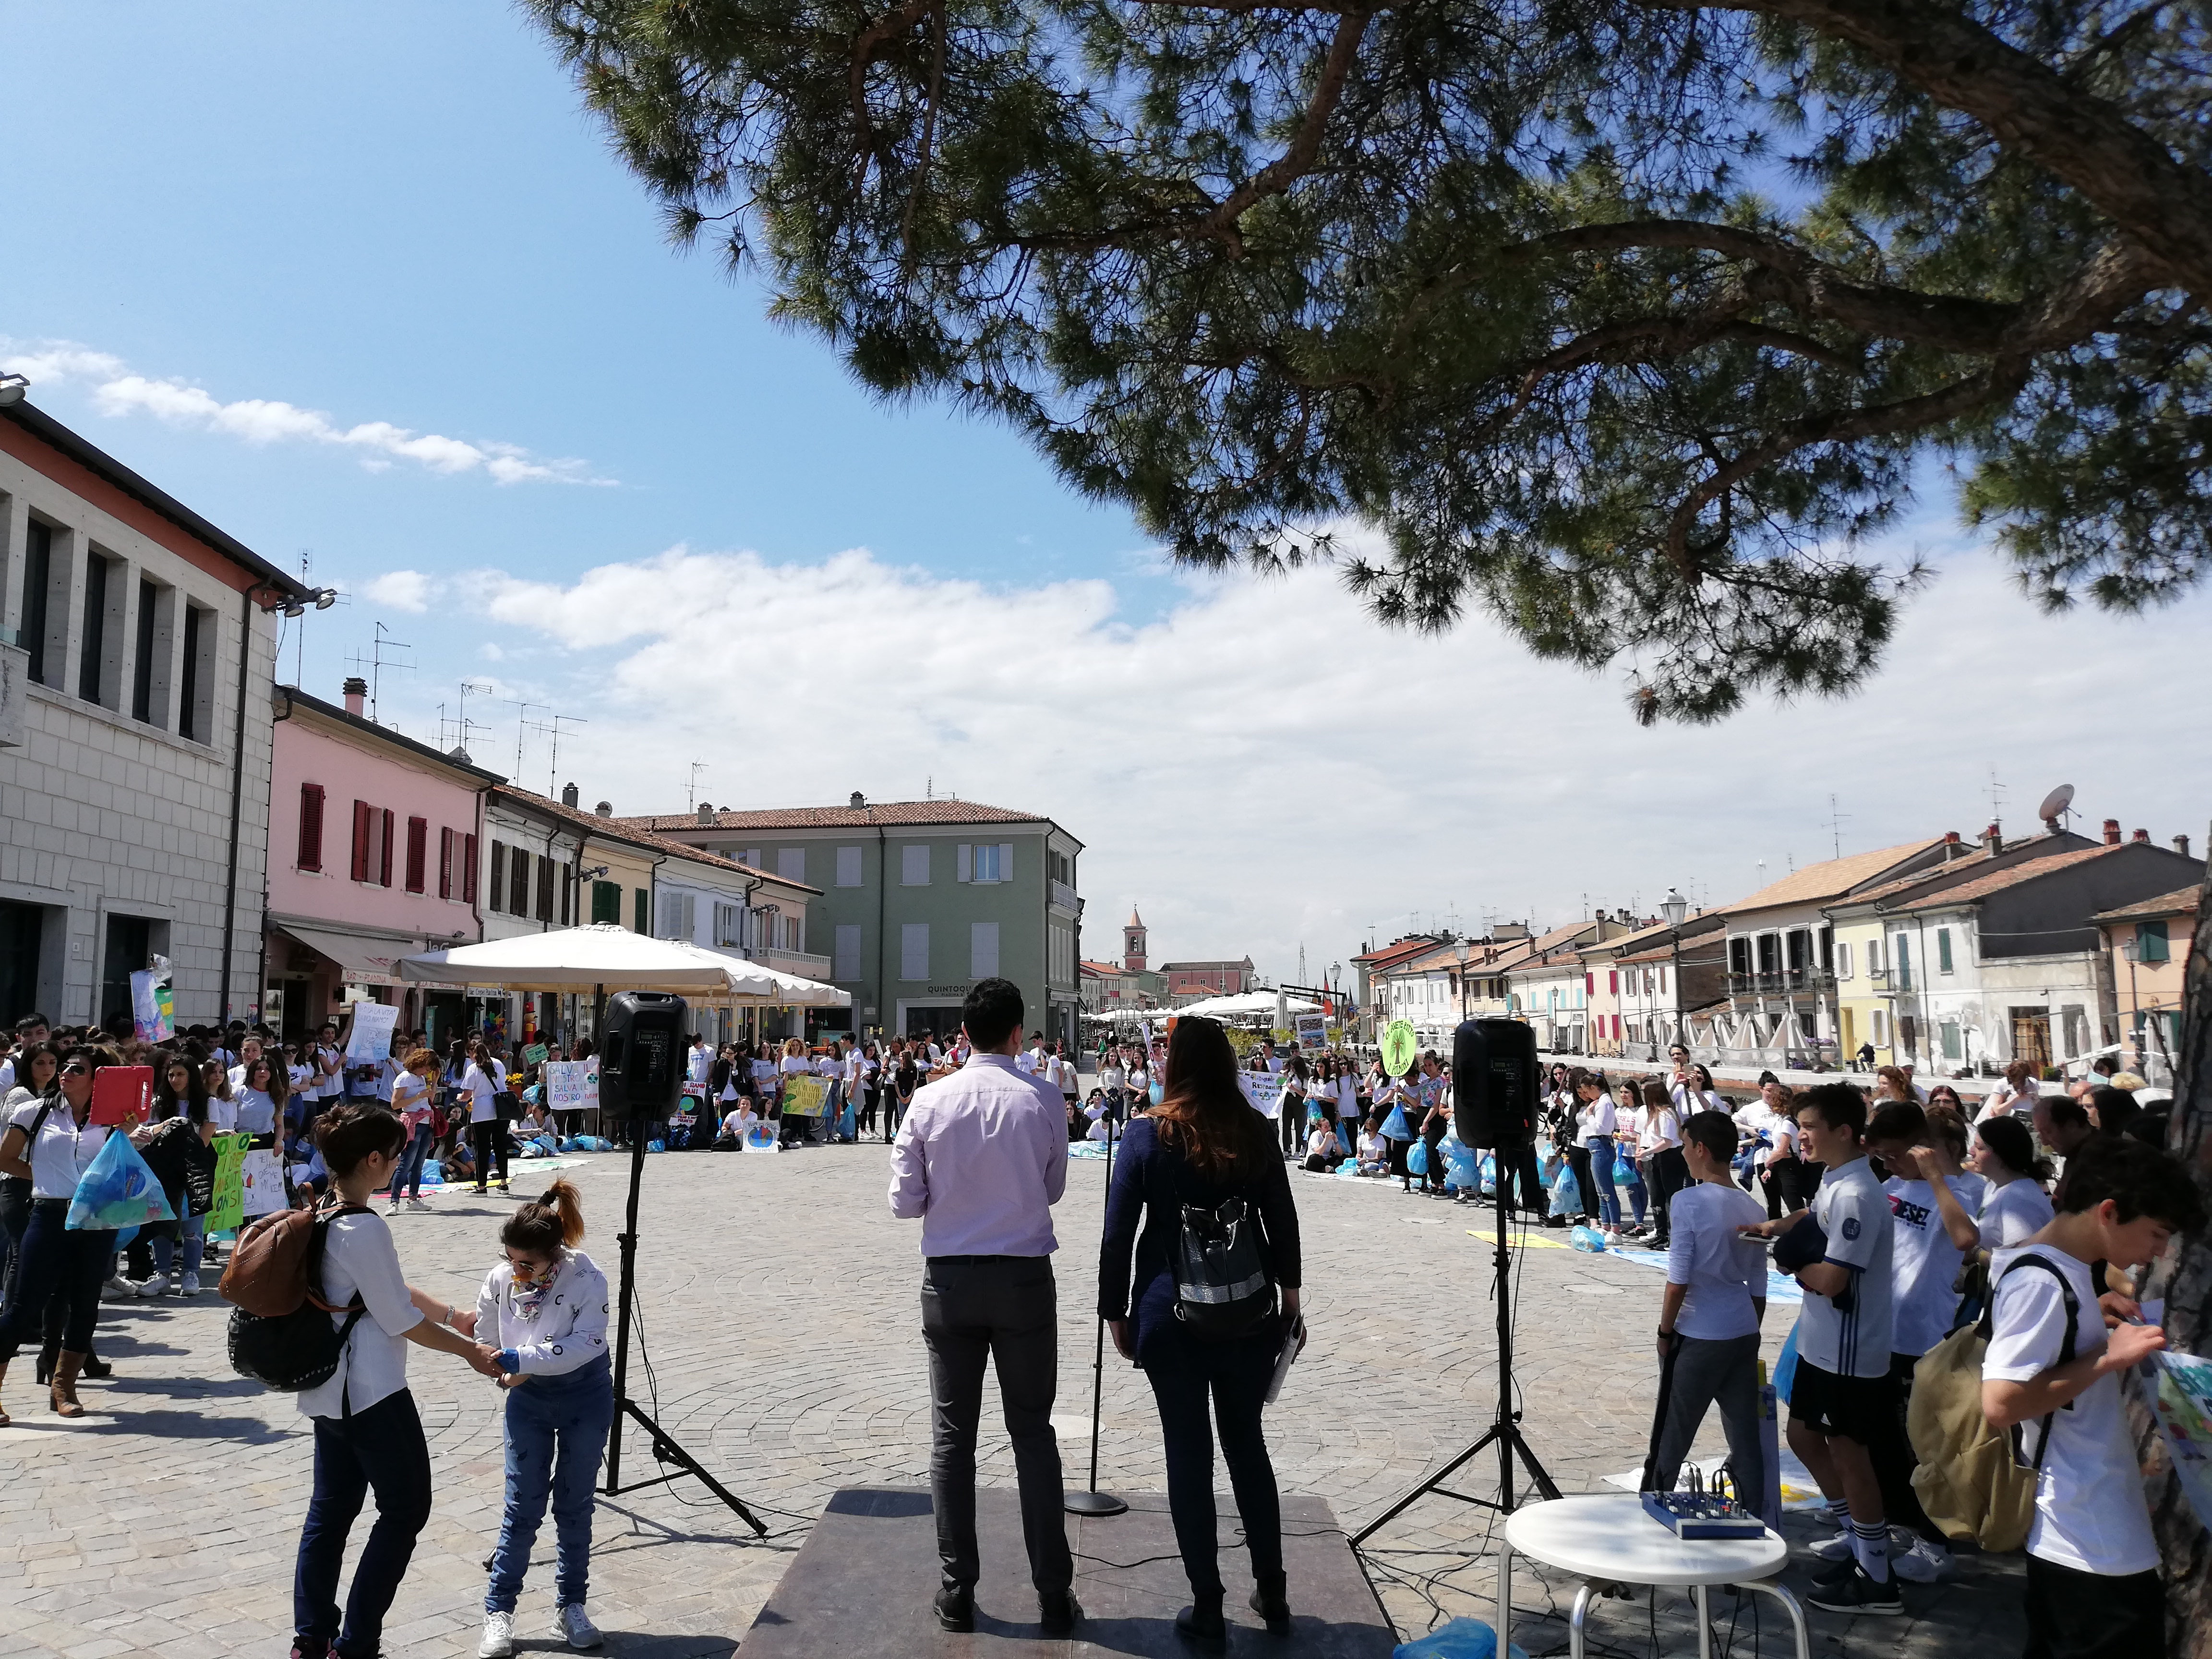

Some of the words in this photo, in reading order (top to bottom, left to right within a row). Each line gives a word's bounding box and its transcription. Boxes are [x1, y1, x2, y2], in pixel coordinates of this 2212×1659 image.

[347, 971, 356, 980] BAR
[364, 974, 386, 984] PIADINA
[1391, 1021, 1403, 1033] AVETE
[1403, 1022, 1414, 1037] ROTTO
[548, 1065, 578, 1074] SALVA
[584, 1064, 591, 1073] IL
[1391, 1058, 1409, 1075] POLMONI
[552, 1074, 581, 1083] NOSTRO
[554, 1084, 577, 1093] SALVA
[553, 1093, 580, 1102] NOSTRO
